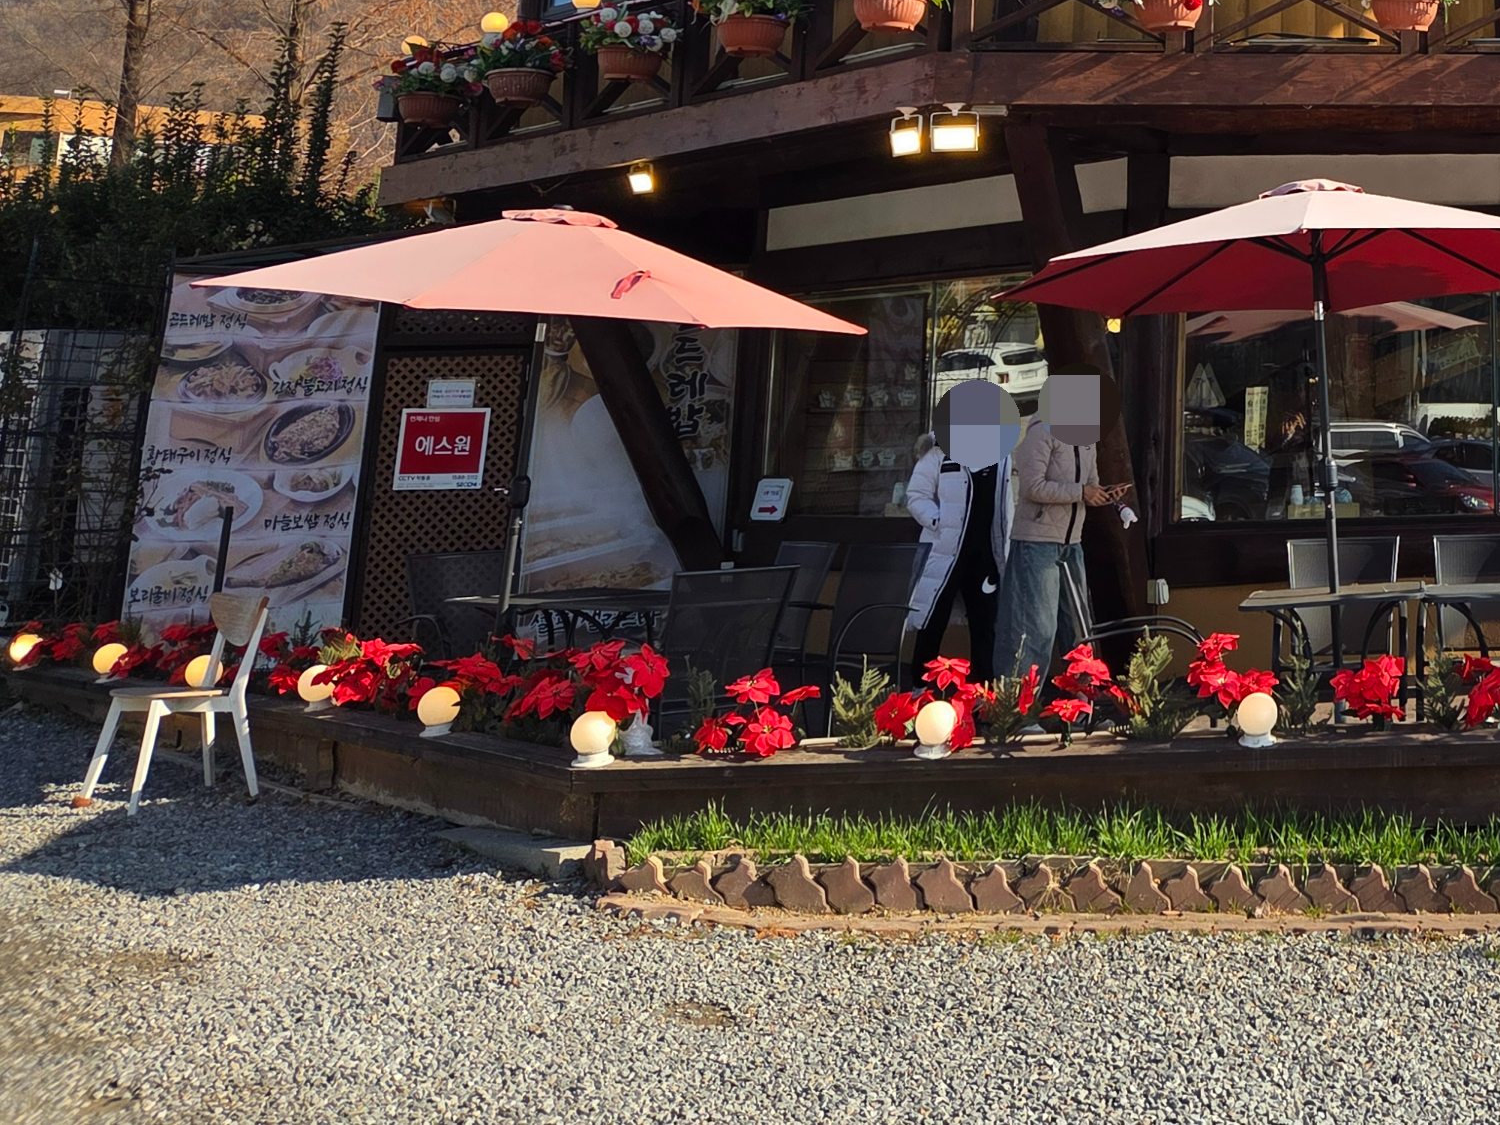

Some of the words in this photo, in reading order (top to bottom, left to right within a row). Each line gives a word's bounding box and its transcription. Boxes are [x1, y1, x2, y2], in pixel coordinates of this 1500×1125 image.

[169, 312, 216, 329] 곤드레밥
[220, 312, 248, 329] 정식
[341, 376, 369, 394] 정식
[666, 324, 709, 438] 드레밥
[147, 445, 200, 465] 황태구이
[204, 446, 233, 464] 정식
[415, 435, 471, 456] 에스원
[264, 514, 319, 532] 마늘보쌈
[324, 512, 351, 529] 정식
[128, 585, 176, 605] 보리굴비
[180, 585, 209, 604] 정식
